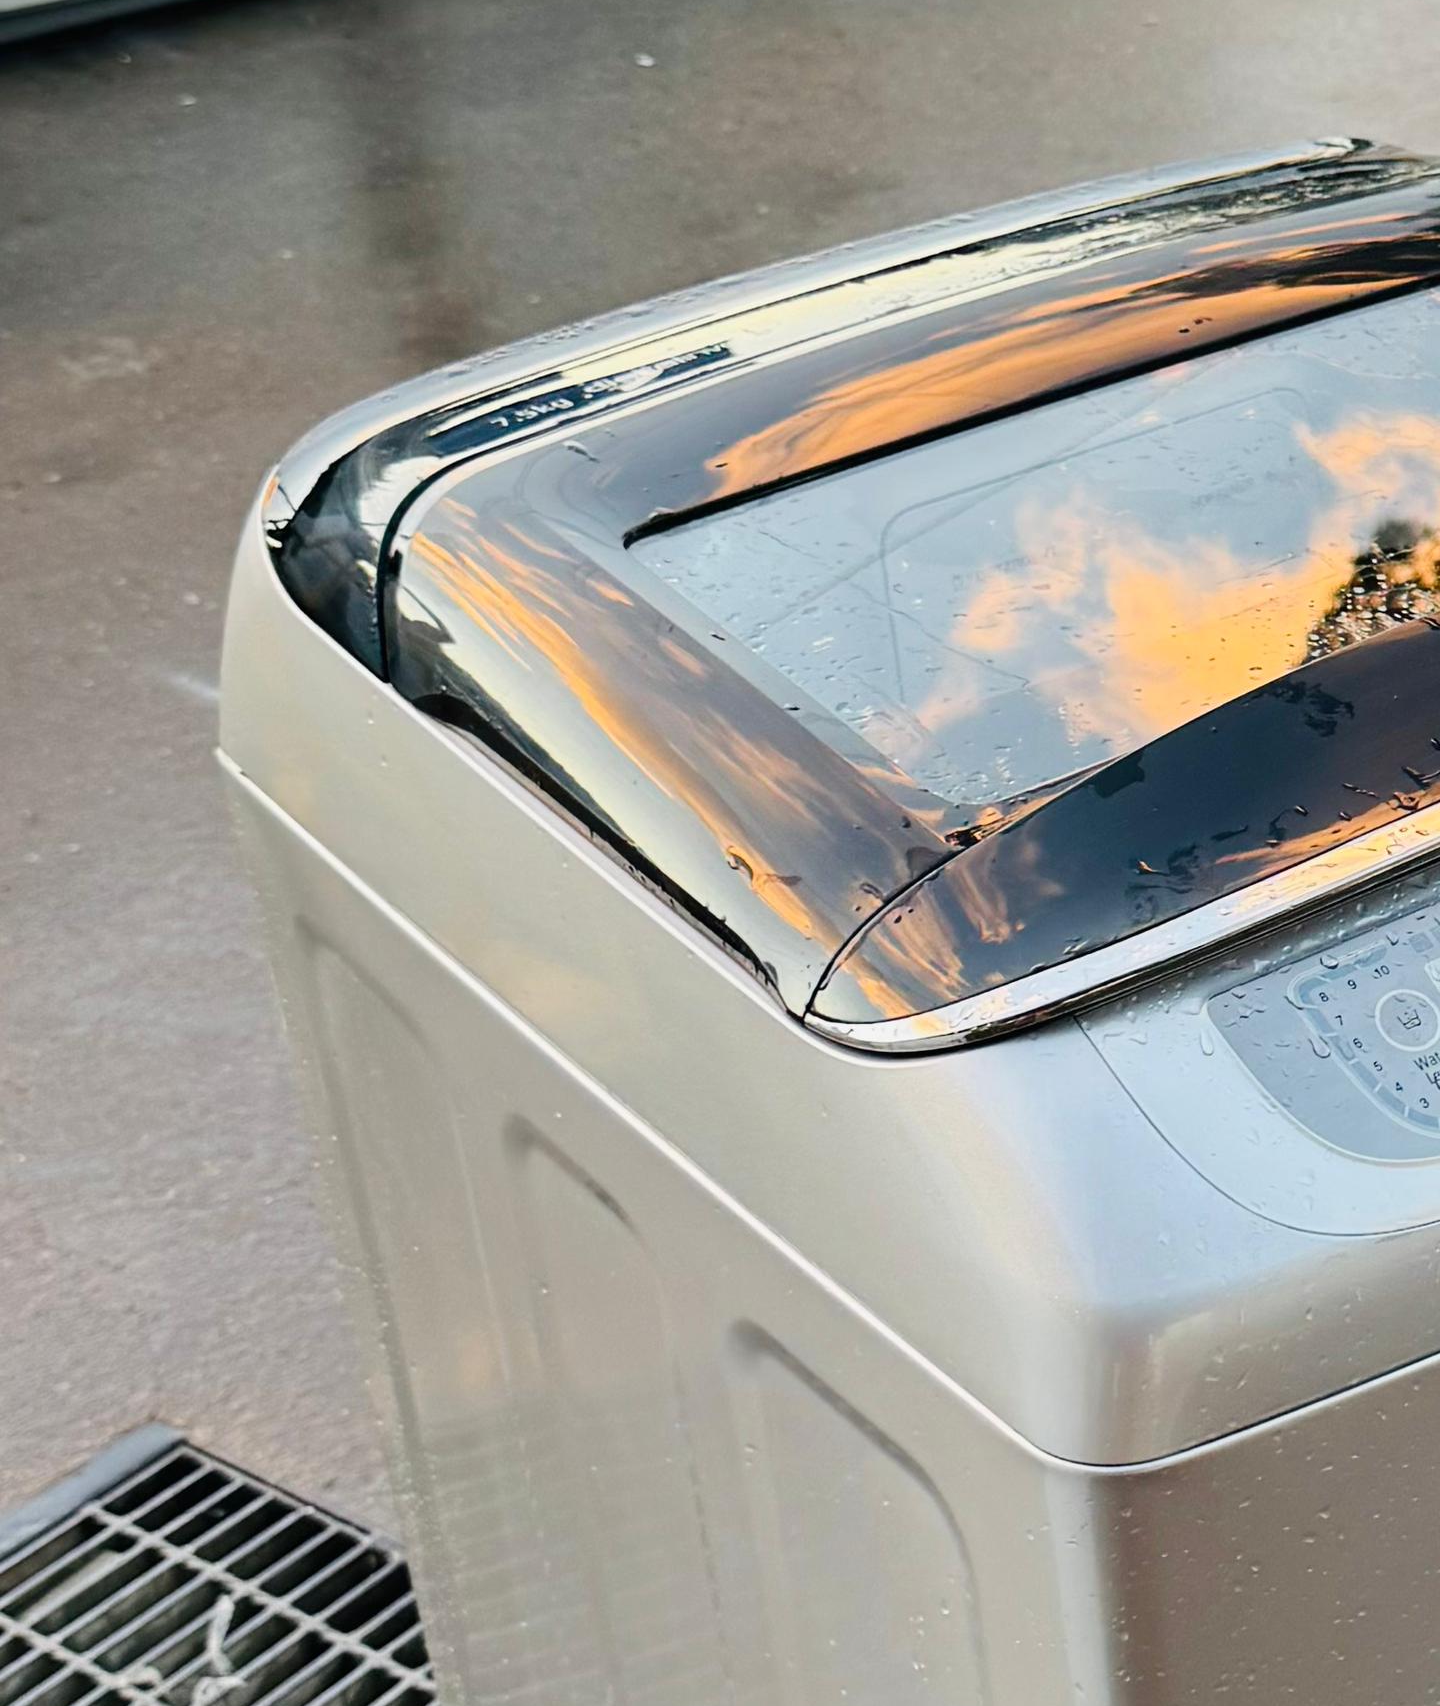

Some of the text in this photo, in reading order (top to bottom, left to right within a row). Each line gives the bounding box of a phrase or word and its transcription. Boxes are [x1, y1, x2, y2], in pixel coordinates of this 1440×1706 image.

[1347, 979, 1358, 990] 9
[1318, 991, 1330, 1003] 8
[1334, 1014, 1345, 1026] 7
[1352, 1037, 1364, 1049] 6
[1372, 1060, 1384, 1072] 5
[1394, 1081, 1404, 1092] 4
[1418, 1097, 1431, 1109] 3
